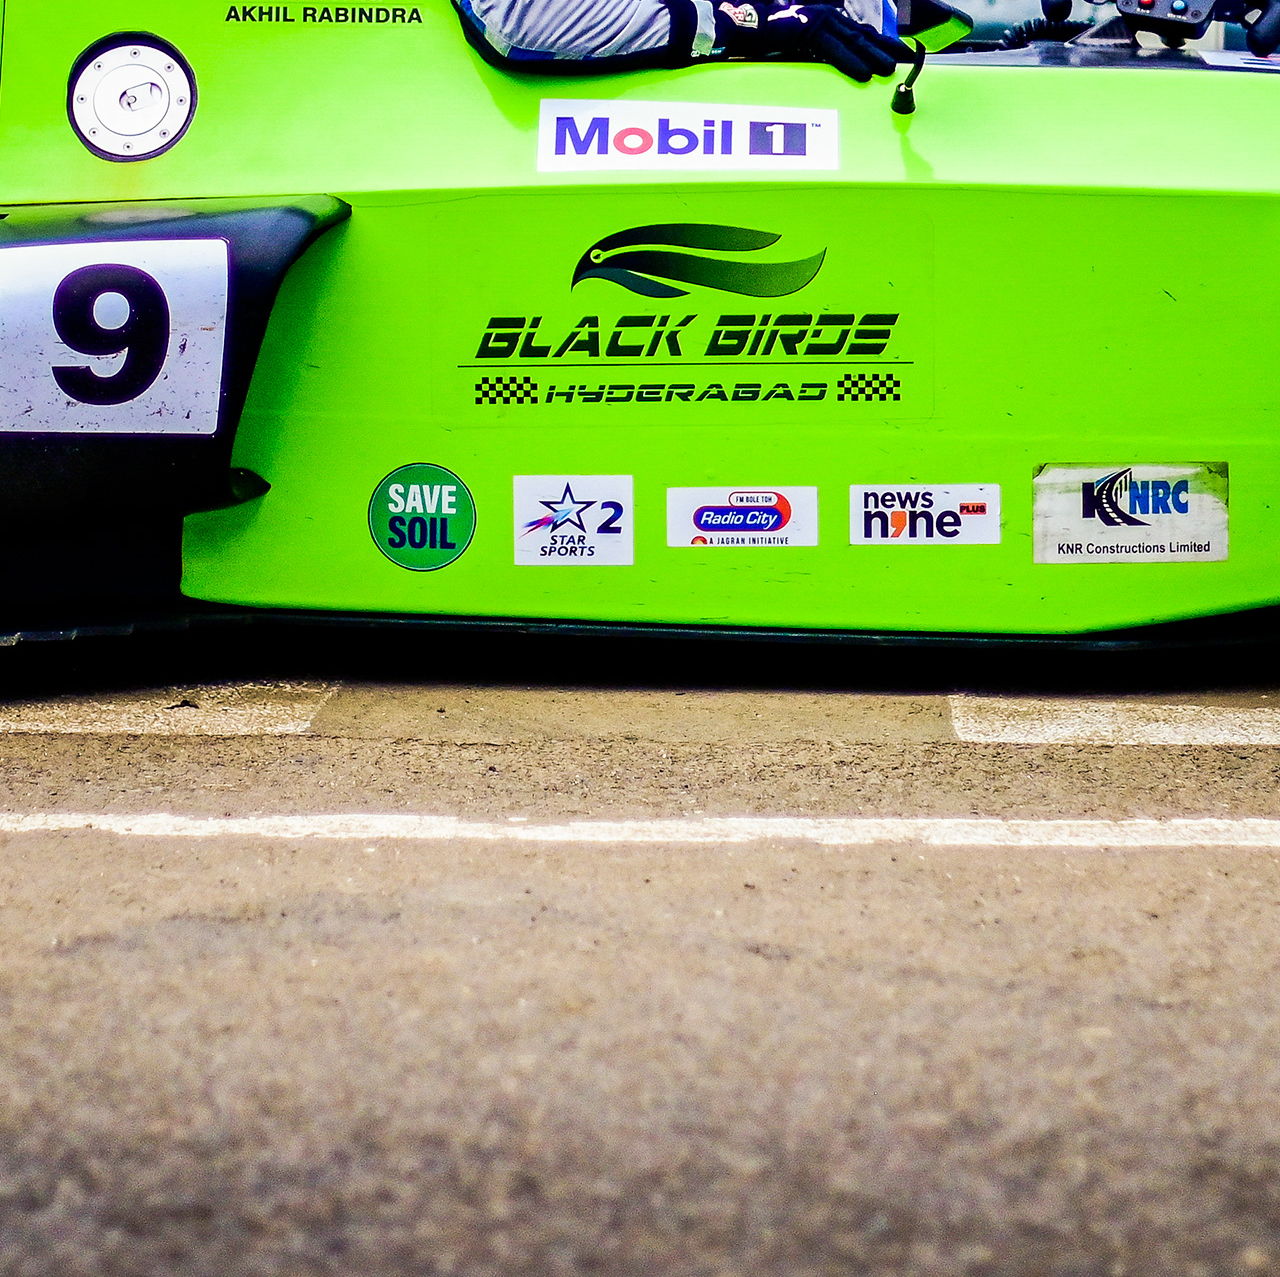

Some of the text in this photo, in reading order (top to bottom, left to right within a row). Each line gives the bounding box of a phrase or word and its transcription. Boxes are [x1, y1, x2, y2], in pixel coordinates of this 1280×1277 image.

[225, 6, 423, 24] AKHIL RABINDRA
[554, 116, 732, 156] Mobil
[51, 263, 171, 406] 9
[475, 313, 900, 358] BLACK BIRDS
[545, 382, 828, 404] HYDERABAD
[388, 483, 457, 514] SAVE
[864, 491, 934, 509] news
[596, 500, 624, 534] 2
[960, 505, 986, 513] PLUS
[700, 511, 778, 530] Radio City
[387, 516, 457, 550] SOIL
[549, 534, 586, 545] STAR
[709, 537, 789, 545] A JAGRAN INITIATIVE
[539, 546, 595, 557] SPORTS
[1057, 541, 1211, 555] KNR Constructions Limited
